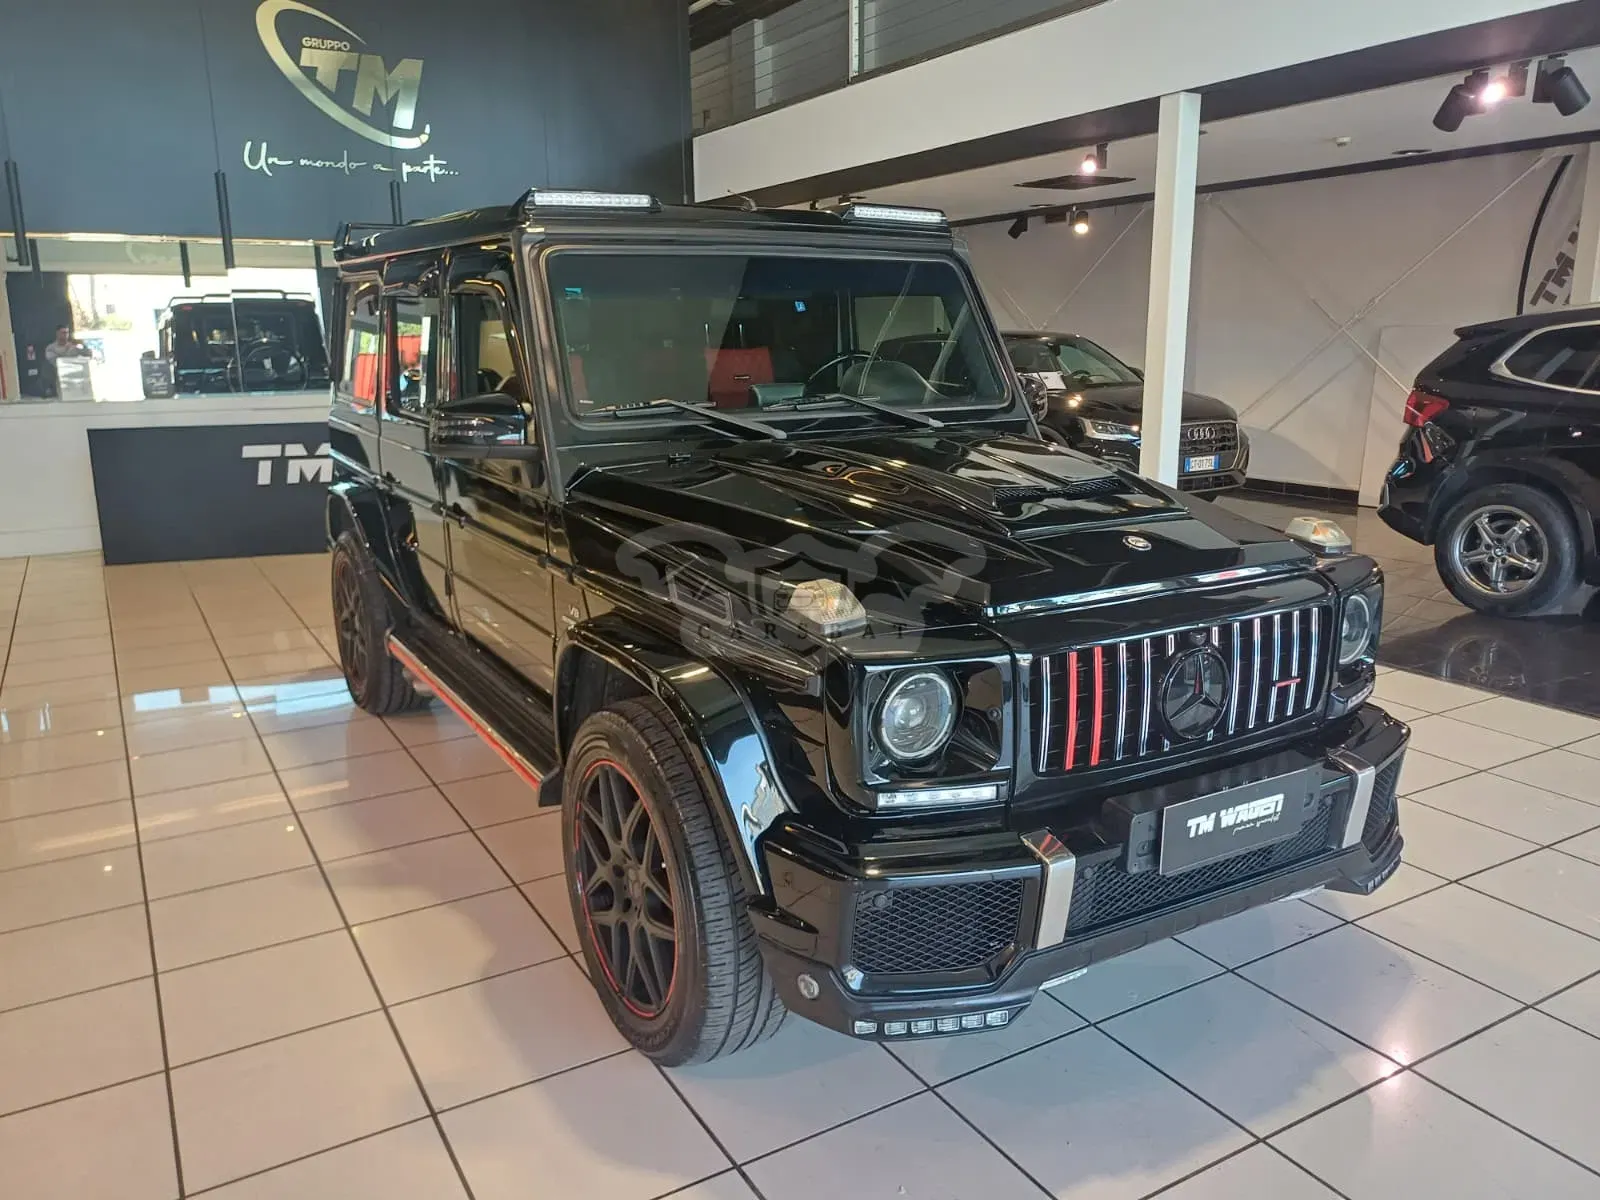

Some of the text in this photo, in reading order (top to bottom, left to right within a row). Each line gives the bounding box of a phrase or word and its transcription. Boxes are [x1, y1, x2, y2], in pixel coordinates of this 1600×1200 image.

[302, 36, 350, 51] GRUPPO
[300, 47, 424, 130] TM
[243, 141, 294, 177] Un
[299, 150, 367, 175] mondo
[372, 163, 397, 172] a
[242, 442, 334, 486] TM
[1186, 812, 1217, 838] TM
